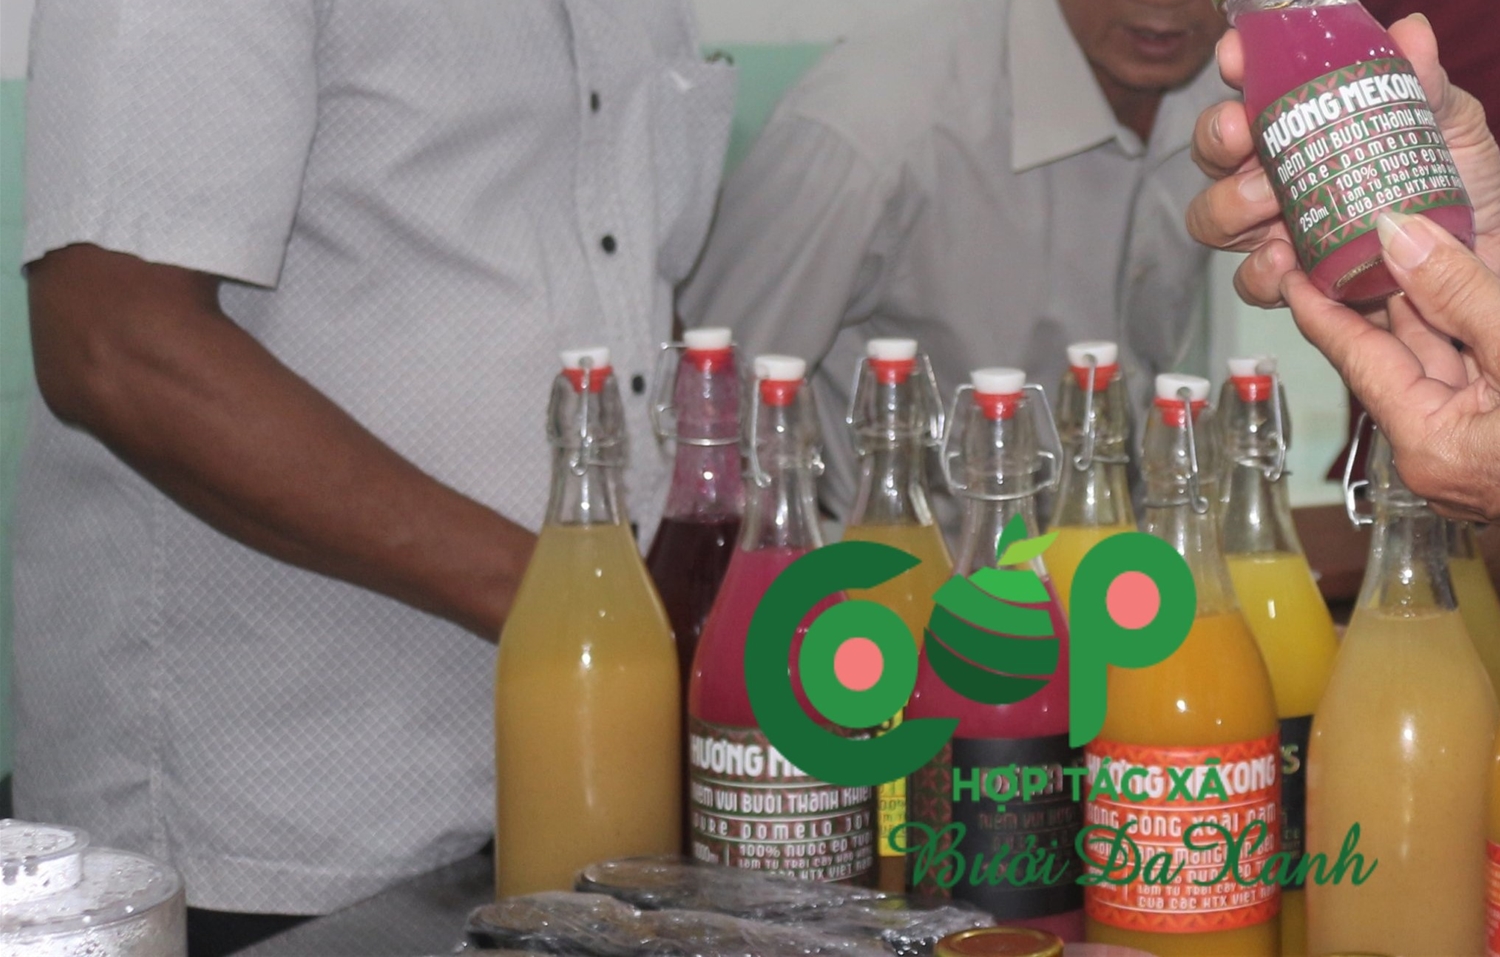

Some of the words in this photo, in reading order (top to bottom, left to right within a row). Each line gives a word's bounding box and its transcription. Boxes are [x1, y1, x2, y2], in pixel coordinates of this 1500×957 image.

[1263, 92, 1342, 158] HƯƠNG
[1305, 137, 1329, 163] VUI
[1336, 164, 1378, 191] 100%
[739, 843, 780, 858] 100%
